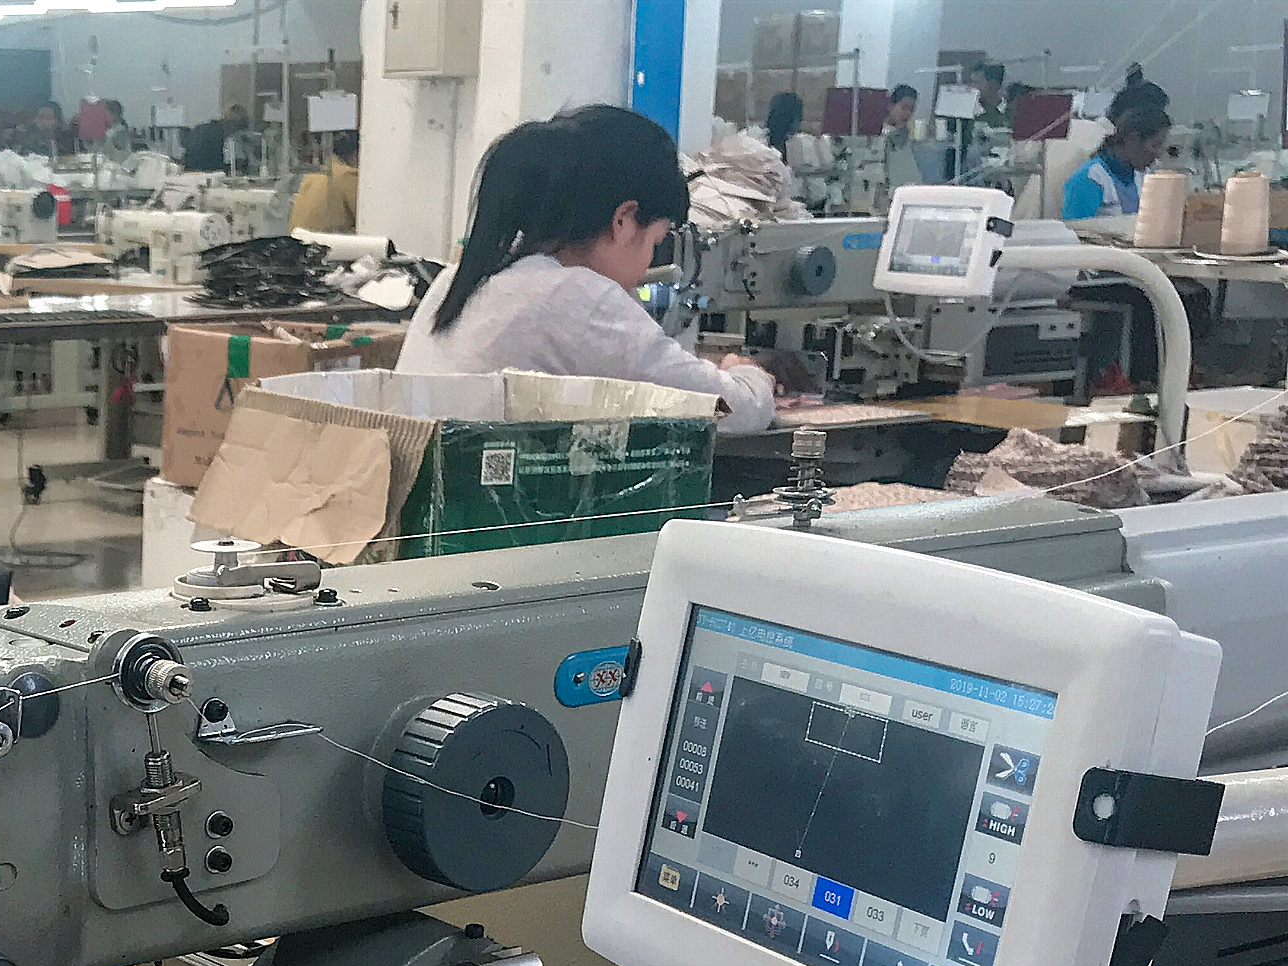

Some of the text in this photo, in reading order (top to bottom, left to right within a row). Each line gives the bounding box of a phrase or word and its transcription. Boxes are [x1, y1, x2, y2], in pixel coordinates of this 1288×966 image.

[911, 709, 933, 723] user
[679, 758, 703, 774] 00053
[675, 775, 699, 792] 00041
[989, 820, 1016, 837] HIGH
[988, 852, 996, 865] 9
[783, 874, 800, 890] 034
[824, 891, 841, 906] 031
[866, 906, 884, 922] 033
[972, 905, 995, 921] LOW
